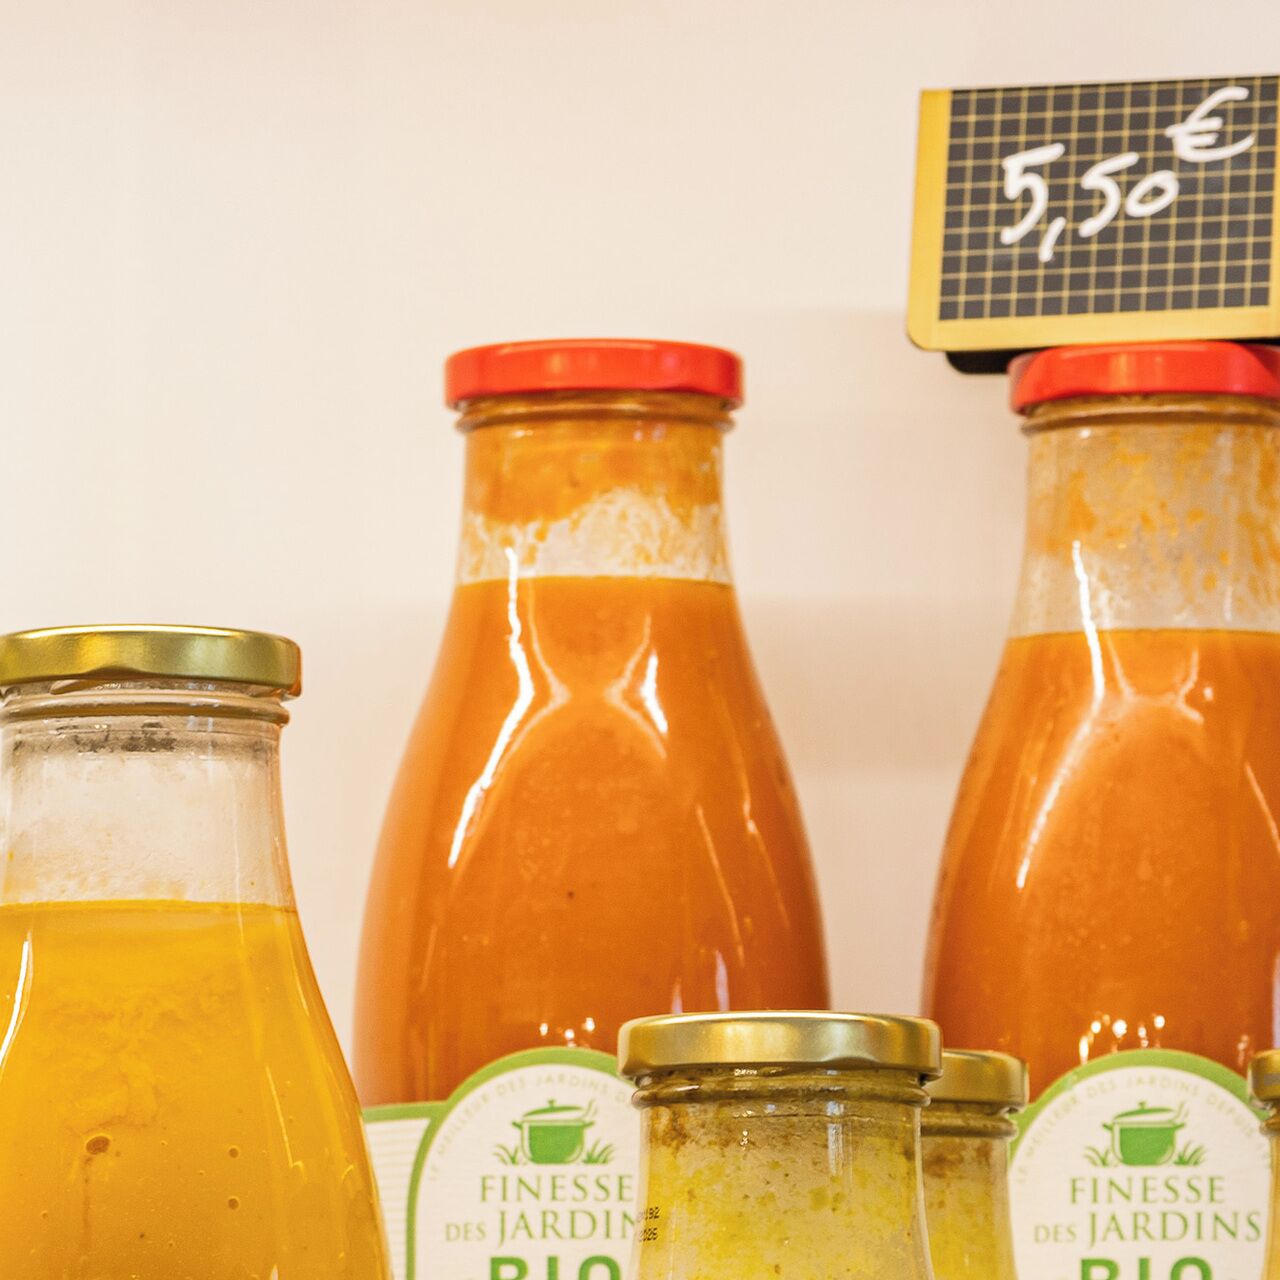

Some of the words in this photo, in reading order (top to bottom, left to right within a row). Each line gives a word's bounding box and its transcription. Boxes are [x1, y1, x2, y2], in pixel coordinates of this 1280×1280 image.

[481, 1175, 633, 1202] FINESSE
[1071, 1177, 1225, 1204] FINESSE
[446, 1223, 486, 1242] DES
[498, 1210, 637, 1246] JARDIN
[1034, 1225, 1076, 1243] DES
[1089, 1212, 1261, 1249] JARDINS
